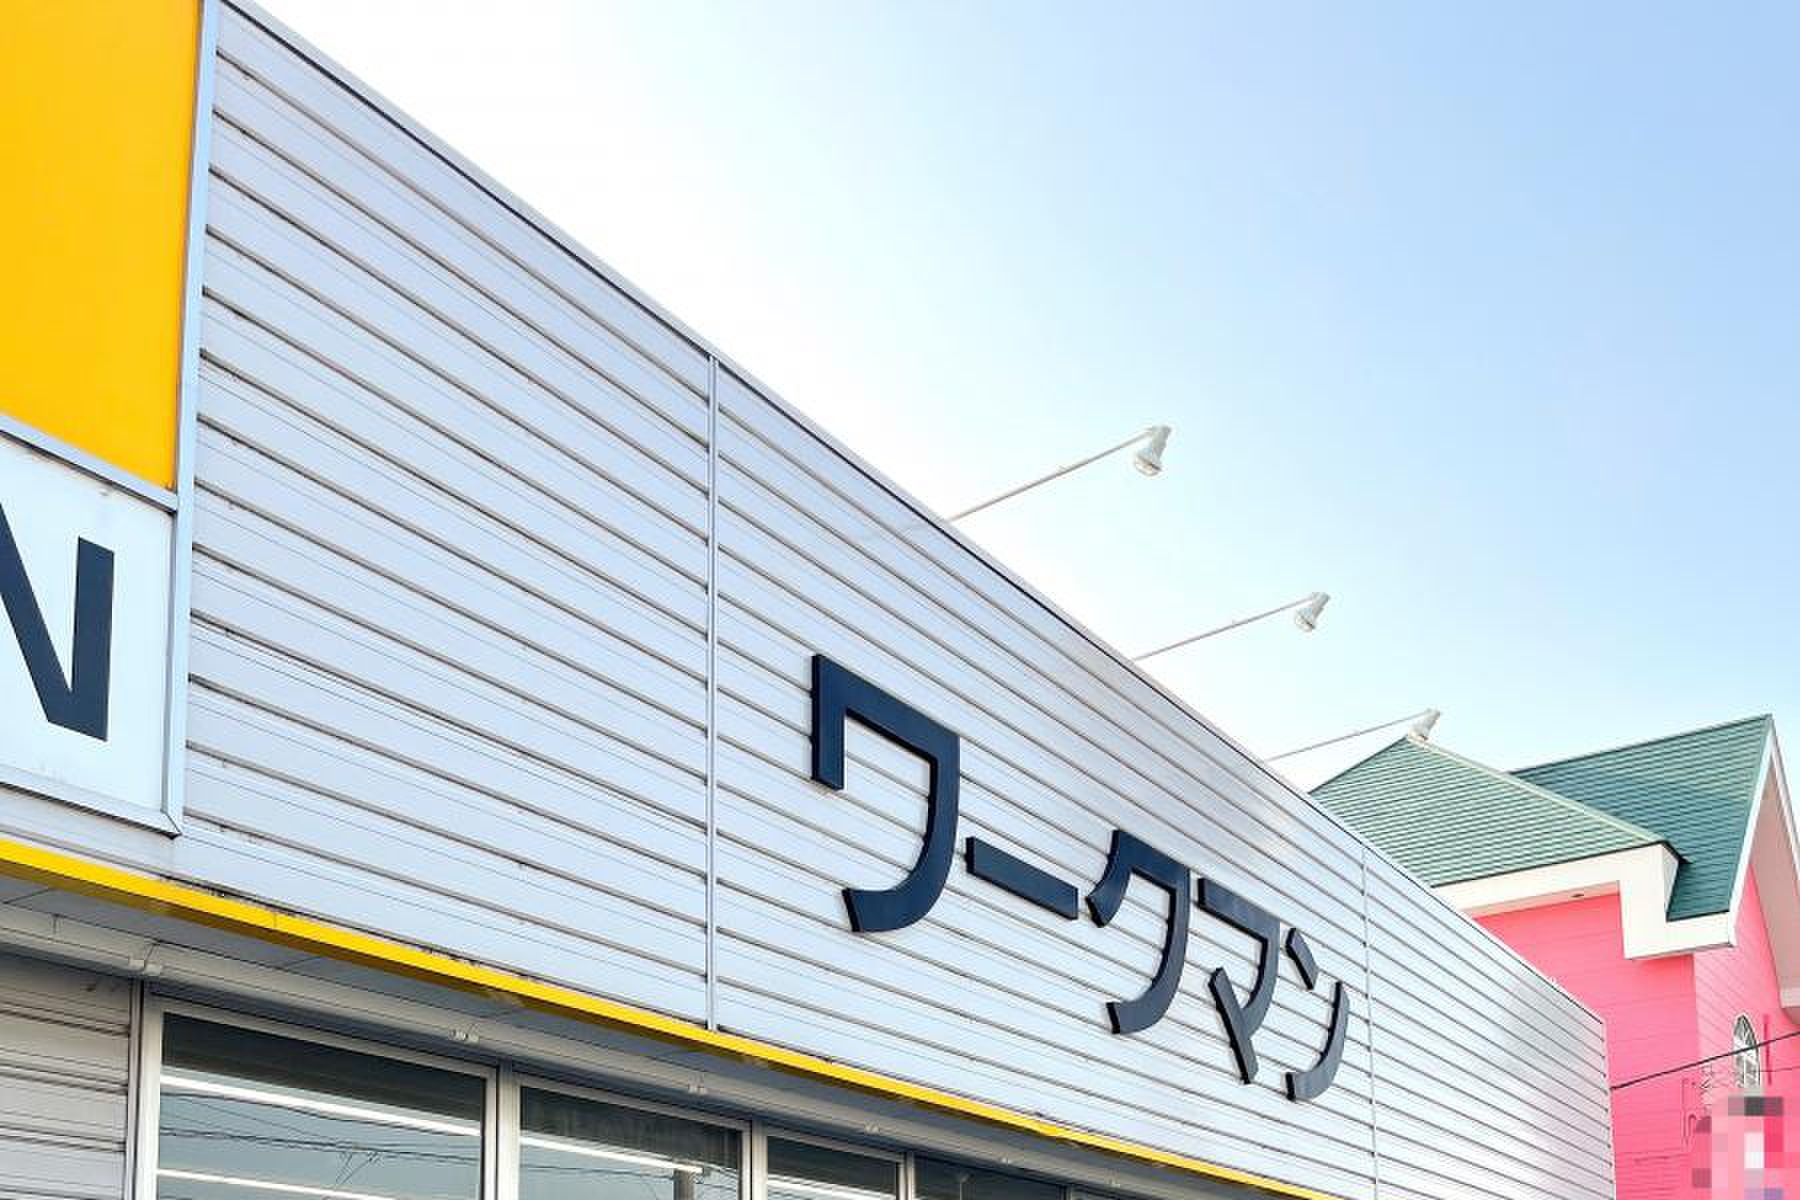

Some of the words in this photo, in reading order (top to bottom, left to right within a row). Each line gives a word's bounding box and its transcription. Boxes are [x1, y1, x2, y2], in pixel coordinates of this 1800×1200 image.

[811, 653, 1350, 1101] ワークマン
